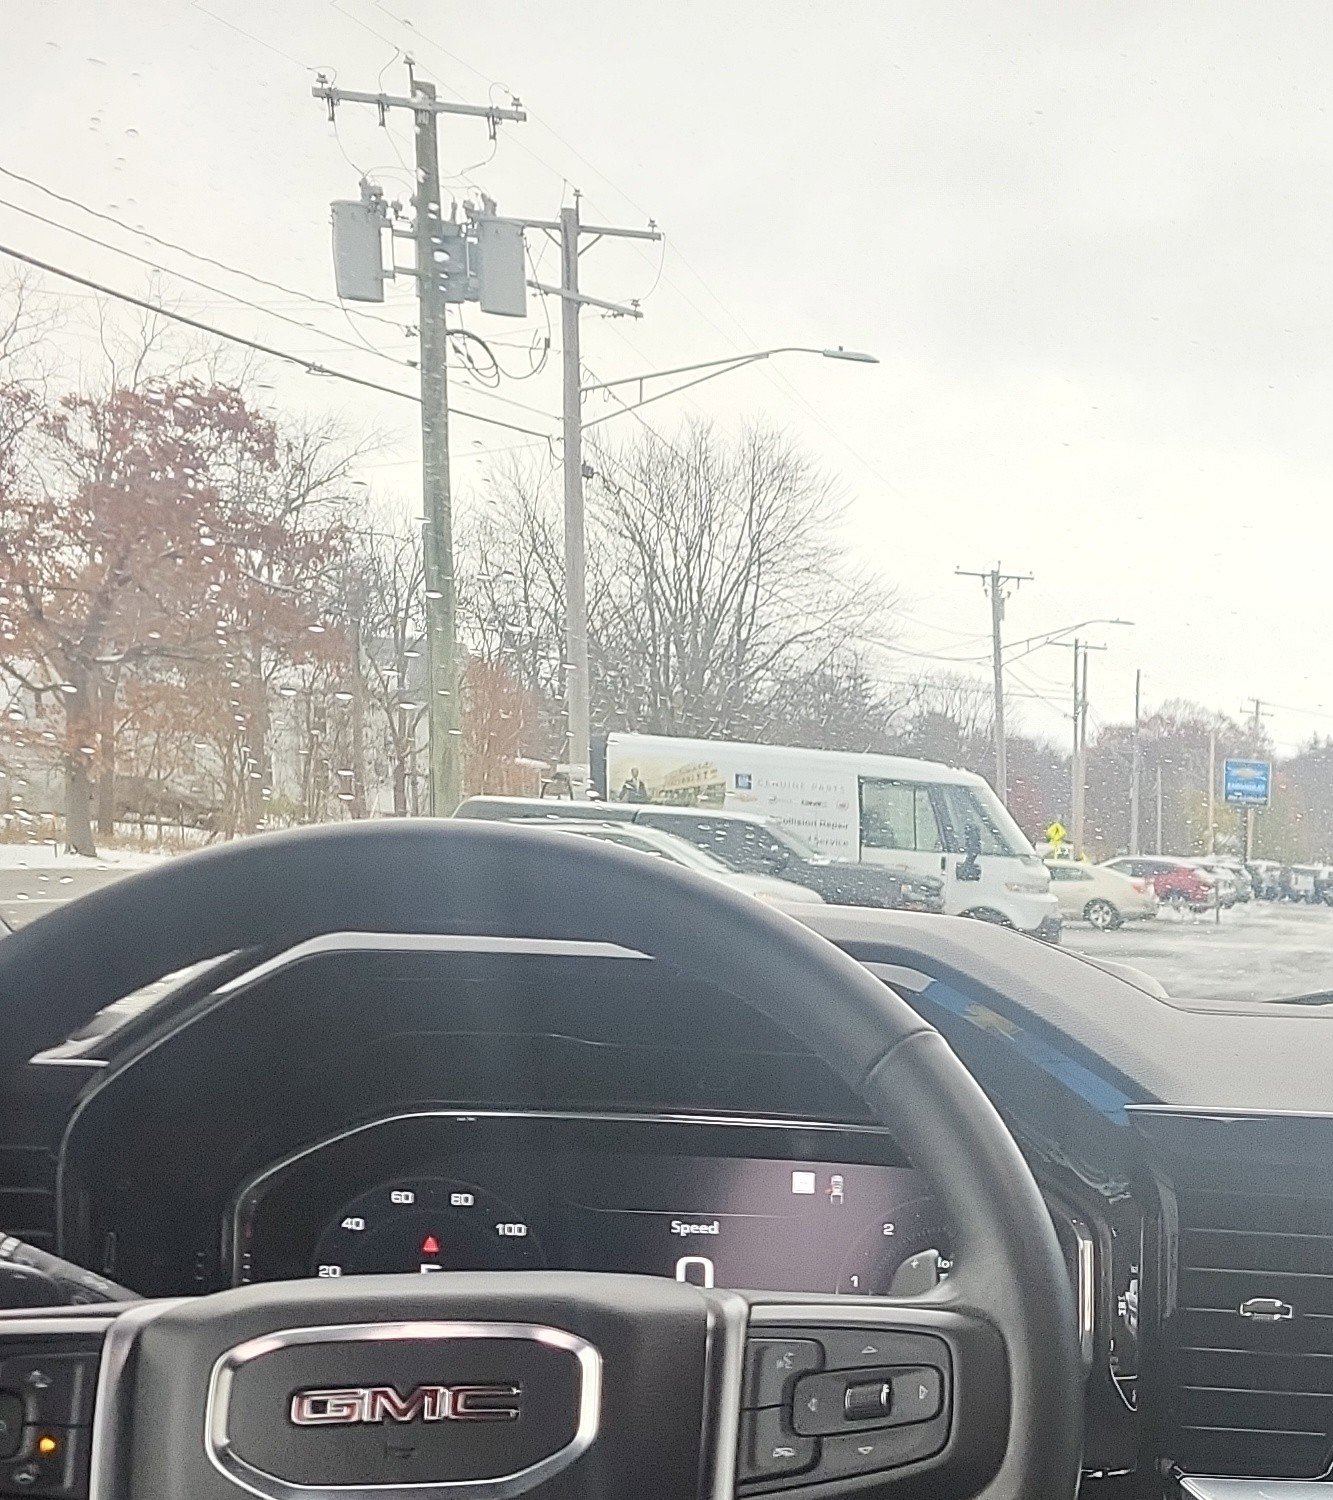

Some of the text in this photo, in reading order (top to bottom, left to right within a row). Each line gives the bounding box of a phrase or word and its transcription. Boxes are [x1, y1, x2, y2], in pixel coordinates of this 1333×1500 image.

[390, 1191, 414, 1204] 60
[450, 1194, 474, 1206] 80
[341, 1218, 365, 1231] 40
[496, 1223, 527, 1237] 100
[671, 1220, 720, 1236] Speed
[882, 1223, 895, 1236] 2
[318, 1265, 341, 1278] 20
[850, 1275, 859, 1288] 1
[291, 1385, 521, 1426] GMC
